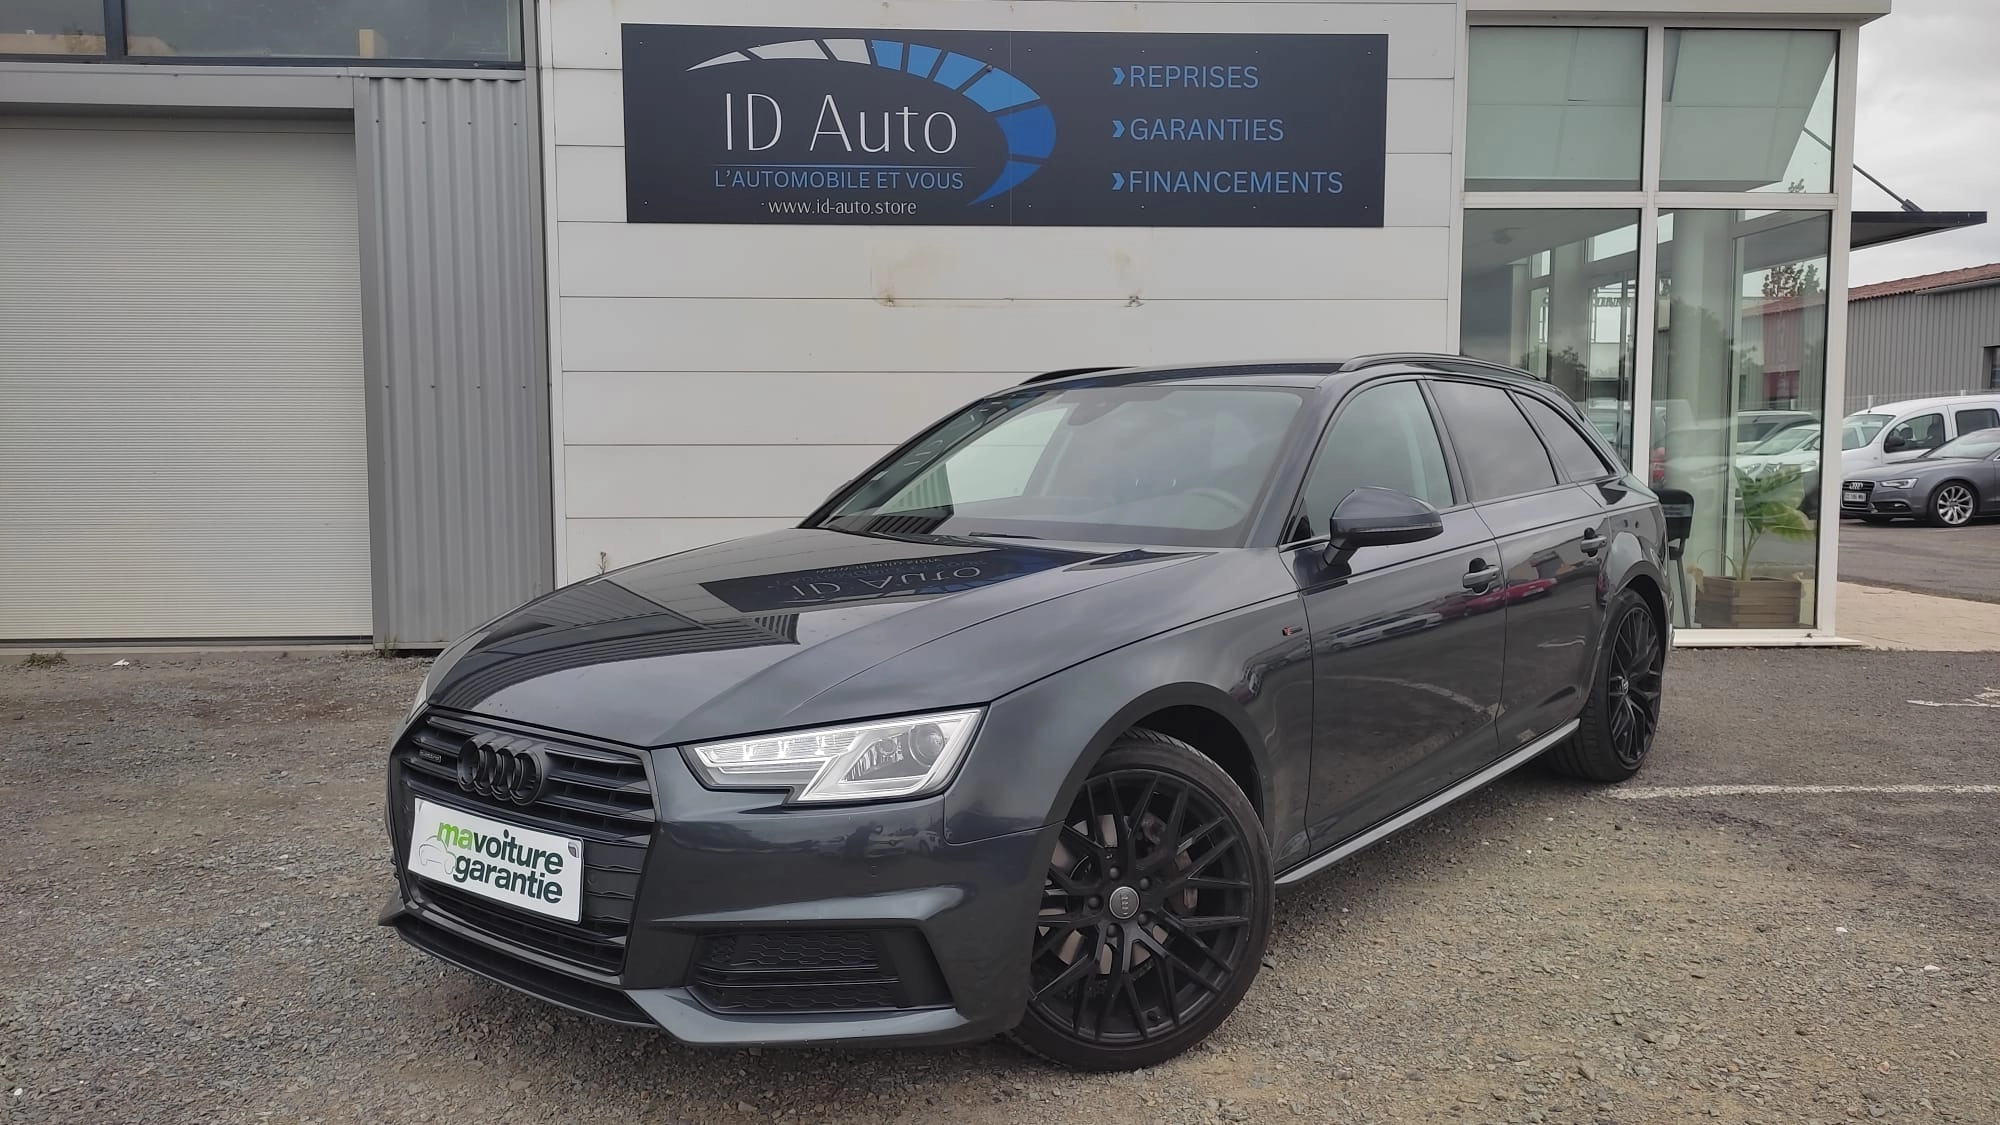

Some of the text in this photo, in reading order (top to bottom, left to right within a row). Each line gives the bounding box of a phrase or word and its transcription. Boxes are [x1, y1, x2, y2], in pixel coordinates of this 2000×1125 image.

[1129, 65, 1259, 89] REPRISES
[725, 92, 958, 154] ID Auto
[1129, 118, 1285, 141] GARANTIES
[876, 171, 901, 189] ET
[905, 172, 965, 190] VOUS
[1129, 170, 1344, 194] FINANCEMENTS
[767, 198, 918, 215] www.id-auto.store
[452, 854, 564, 904] garantie
